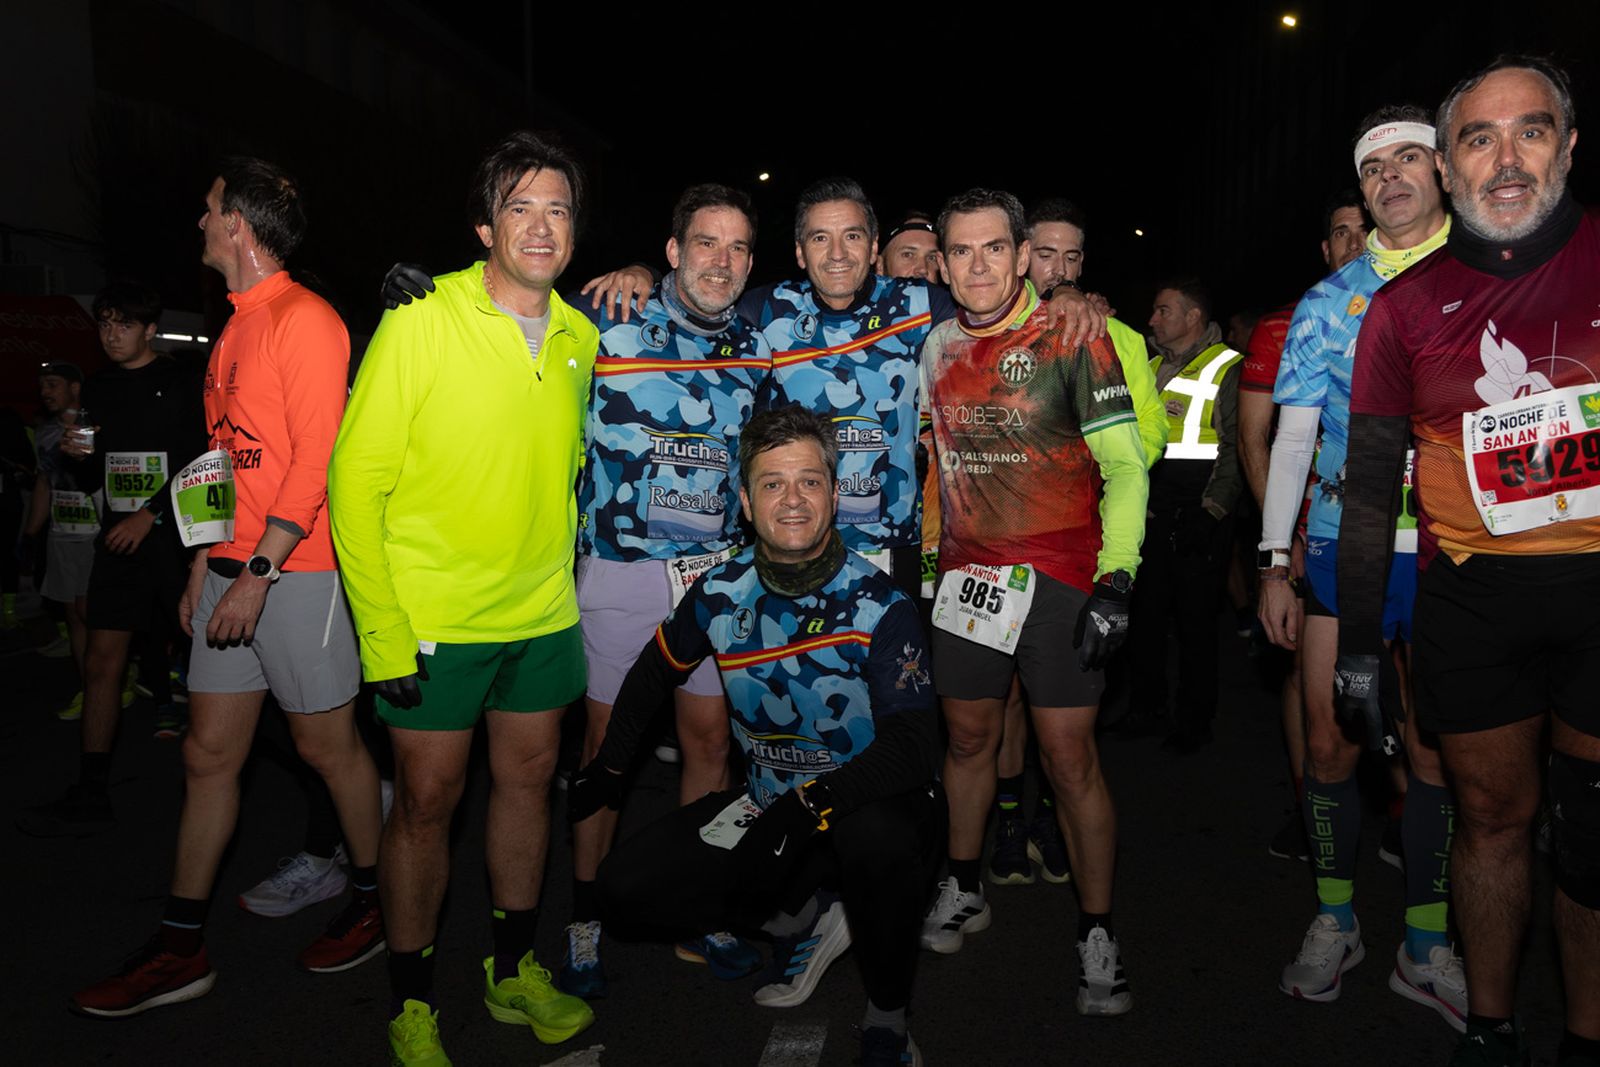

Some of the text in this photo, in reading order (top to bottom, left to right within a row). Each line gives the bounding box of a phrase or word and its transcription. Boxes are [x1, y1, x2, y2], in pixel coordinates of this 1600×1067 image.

[1499, 404, 1566, 430] NOCHE DE
[1483, 432, 1514, 450] SAN
[1517, 419, 1570, 443] ANÓN
[650, 436, 728, 462] Truch@s
[1496, 431, 1600, 488] 5929
[191, 460, 221, 476] NOCHE
[114, 473, 155, 491] 9552
[182, 474, 202, 490] SAN
[839, 472, 881, 493] ales
[649, 485, 725, 511] Rosales
[688, 559, 714, 572] NOCHE
[714, 555, 724, 566] DE
[958, 576, 1008, 615] 985
[958, 605, 973, 615] JUAN
[748, 737, 832, 764] Truch@s
